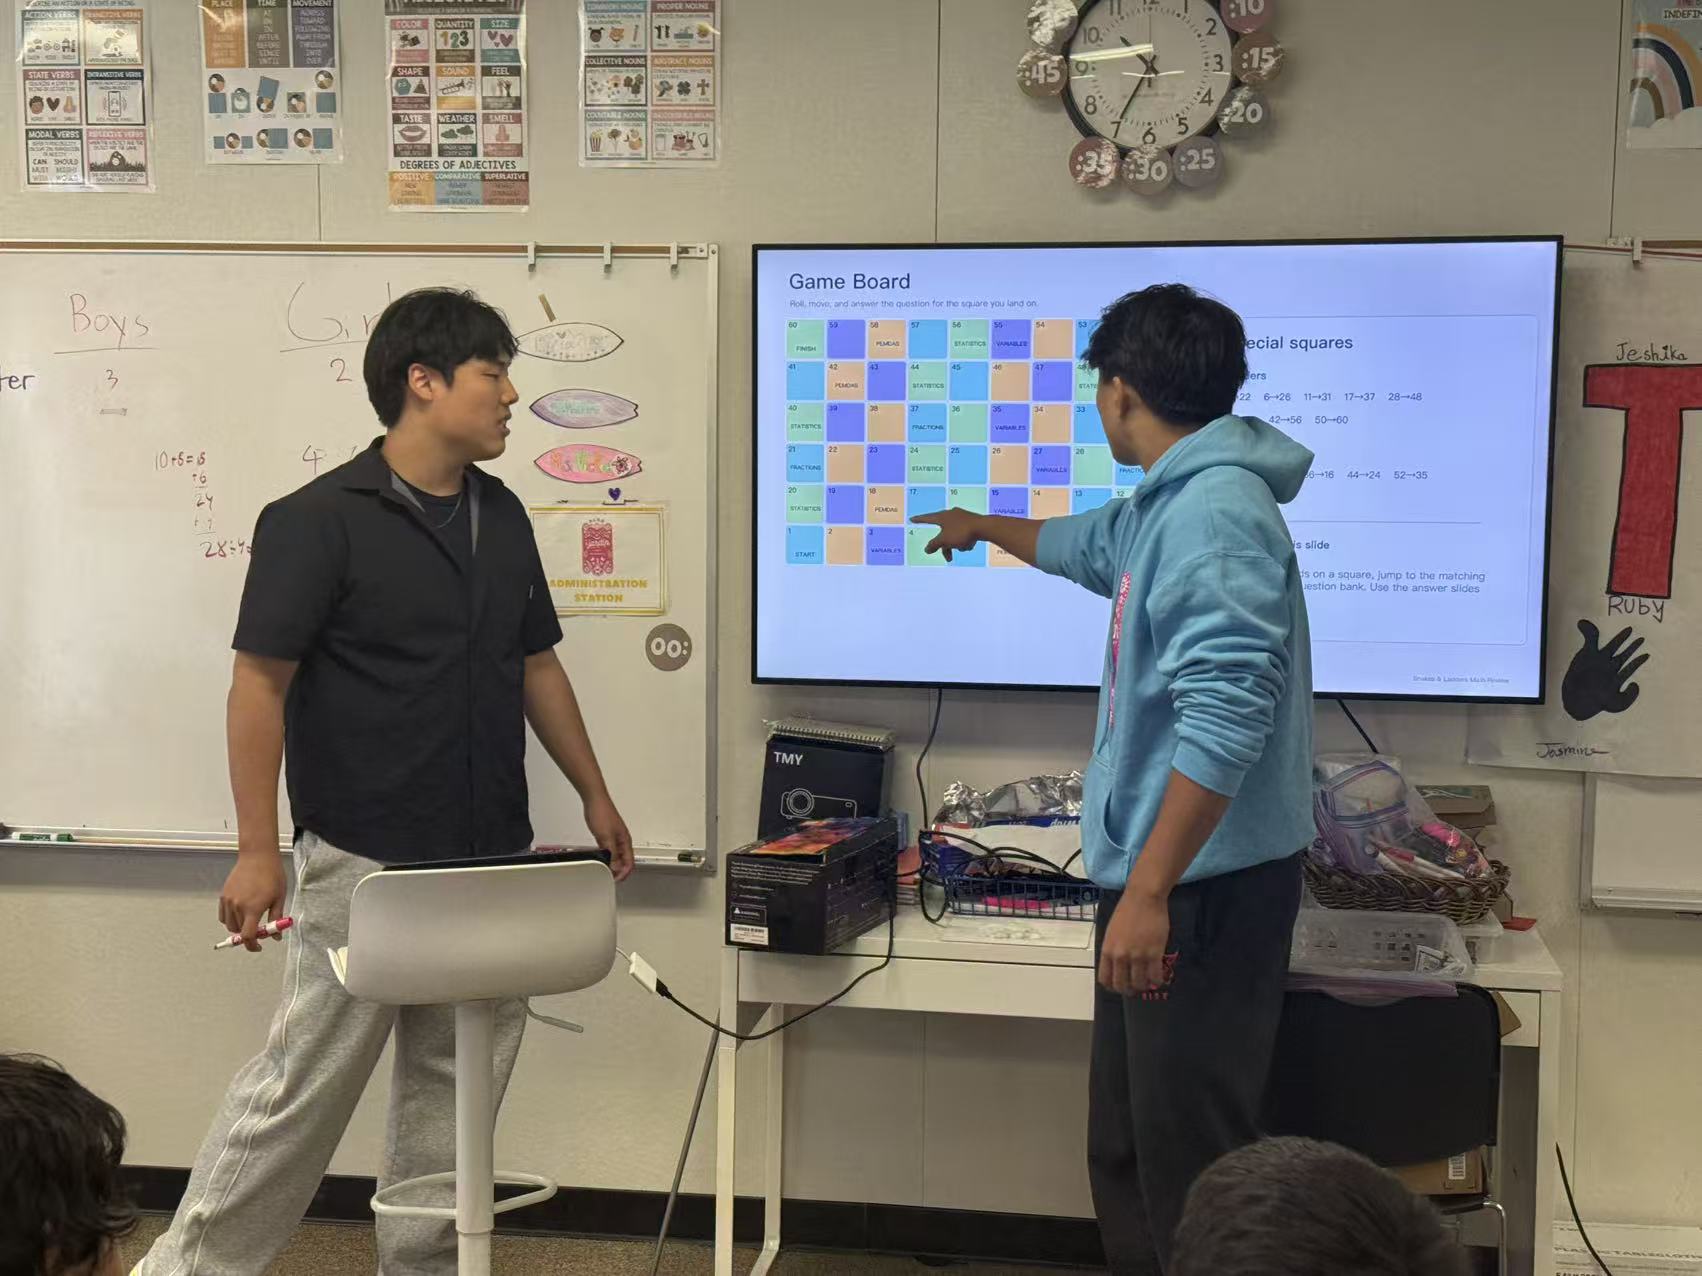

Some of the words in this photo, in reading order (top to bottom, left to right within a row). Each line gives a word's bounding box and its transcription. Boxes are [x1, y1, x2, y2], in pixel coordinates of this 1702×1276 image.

[491, 20, 510, 28] SIZE
[1205, 18, 1217, 35] 2
[1082, 26, 1100, 44] 10
[1212, 54, 1224, 72] 3
[1243, 46, 1274, 69] :15
[398, 67, 423, 75] SHAPE
[491, 67, 509, 75] FEEL
[1025, 64, 1060, 87] :45
[1199, 87, 1214, 106] 4
[1084, 95, 1097, 115] 8
[400, 114, 423, 123] TASTE
[438, 114, 475, 123] WEATHER
[1111, 121, 1121, 138] 7
[1177, 118, 1189, 135] 5
[1143, 127, 1155, 145] 6
[400, 160, 439, 169] DEGREES
[443, 160, 455, 169] OF
[459, 160, 516, 169] ADJECTIVES
[1180, 148, 1215, 171] :25
[1129, 158, 1167, 181] :30
[789, 273, 846, 290] Game
[853, 272, 911, 290] Board
[834, 299, 849, 308] and
[880, 299, 894, 308] the
[895, 299, 929, 310] question
[932, 299, 944, 308] for
[946, 299, 959, 308] the
[961, 300, 989, 310] square
[990, 301, 1005, 310] you
[1007, 299, 1025, 308] land
[70, 293, 149, 351] Boys
[788, 321, 798, 329] 60
[828, 321, 839, 329] 59
[911, 321, 920, 329] 57
[952, 321, 962, 329] 56
[1035, 321, 1045, 329] 54
[1078, 321, 1087, 329] 53
[1246, 336, 1284, 350] ecial
[1289, 337, 1354, 352] squares
[330, 357, 353, 382] 2
[106, 369, 119, 390] 3
[1034, 405, 1044, 413] 34
[1076, 405, 1086, 413] 33
[1305, 540, 1330, 550] slide
[550, 579, 648, 589] ADMINISTRATION
[1312, 571, 1326, 579] on
[1338, 571, 1375, 582] square,
[1377, 571, 1401, 582] jump
[1405, 571, 1416, 580] to
[1419, 571, 1436, 581] the
[1438, 571, 1486, 584] matching
[1339, 582, 1367, 592] bank.
[1370, 583, 1390, 592] Use
[1392, 583, 1409, 592] the
[1412, 585, 1448, 593] answer
[1450, 583, 1481, 594] slides
[574, 593, 624, 603] STATION
[1608, 595, 1665, 622] Ruby
[774, 750, 803, 767] TMY
